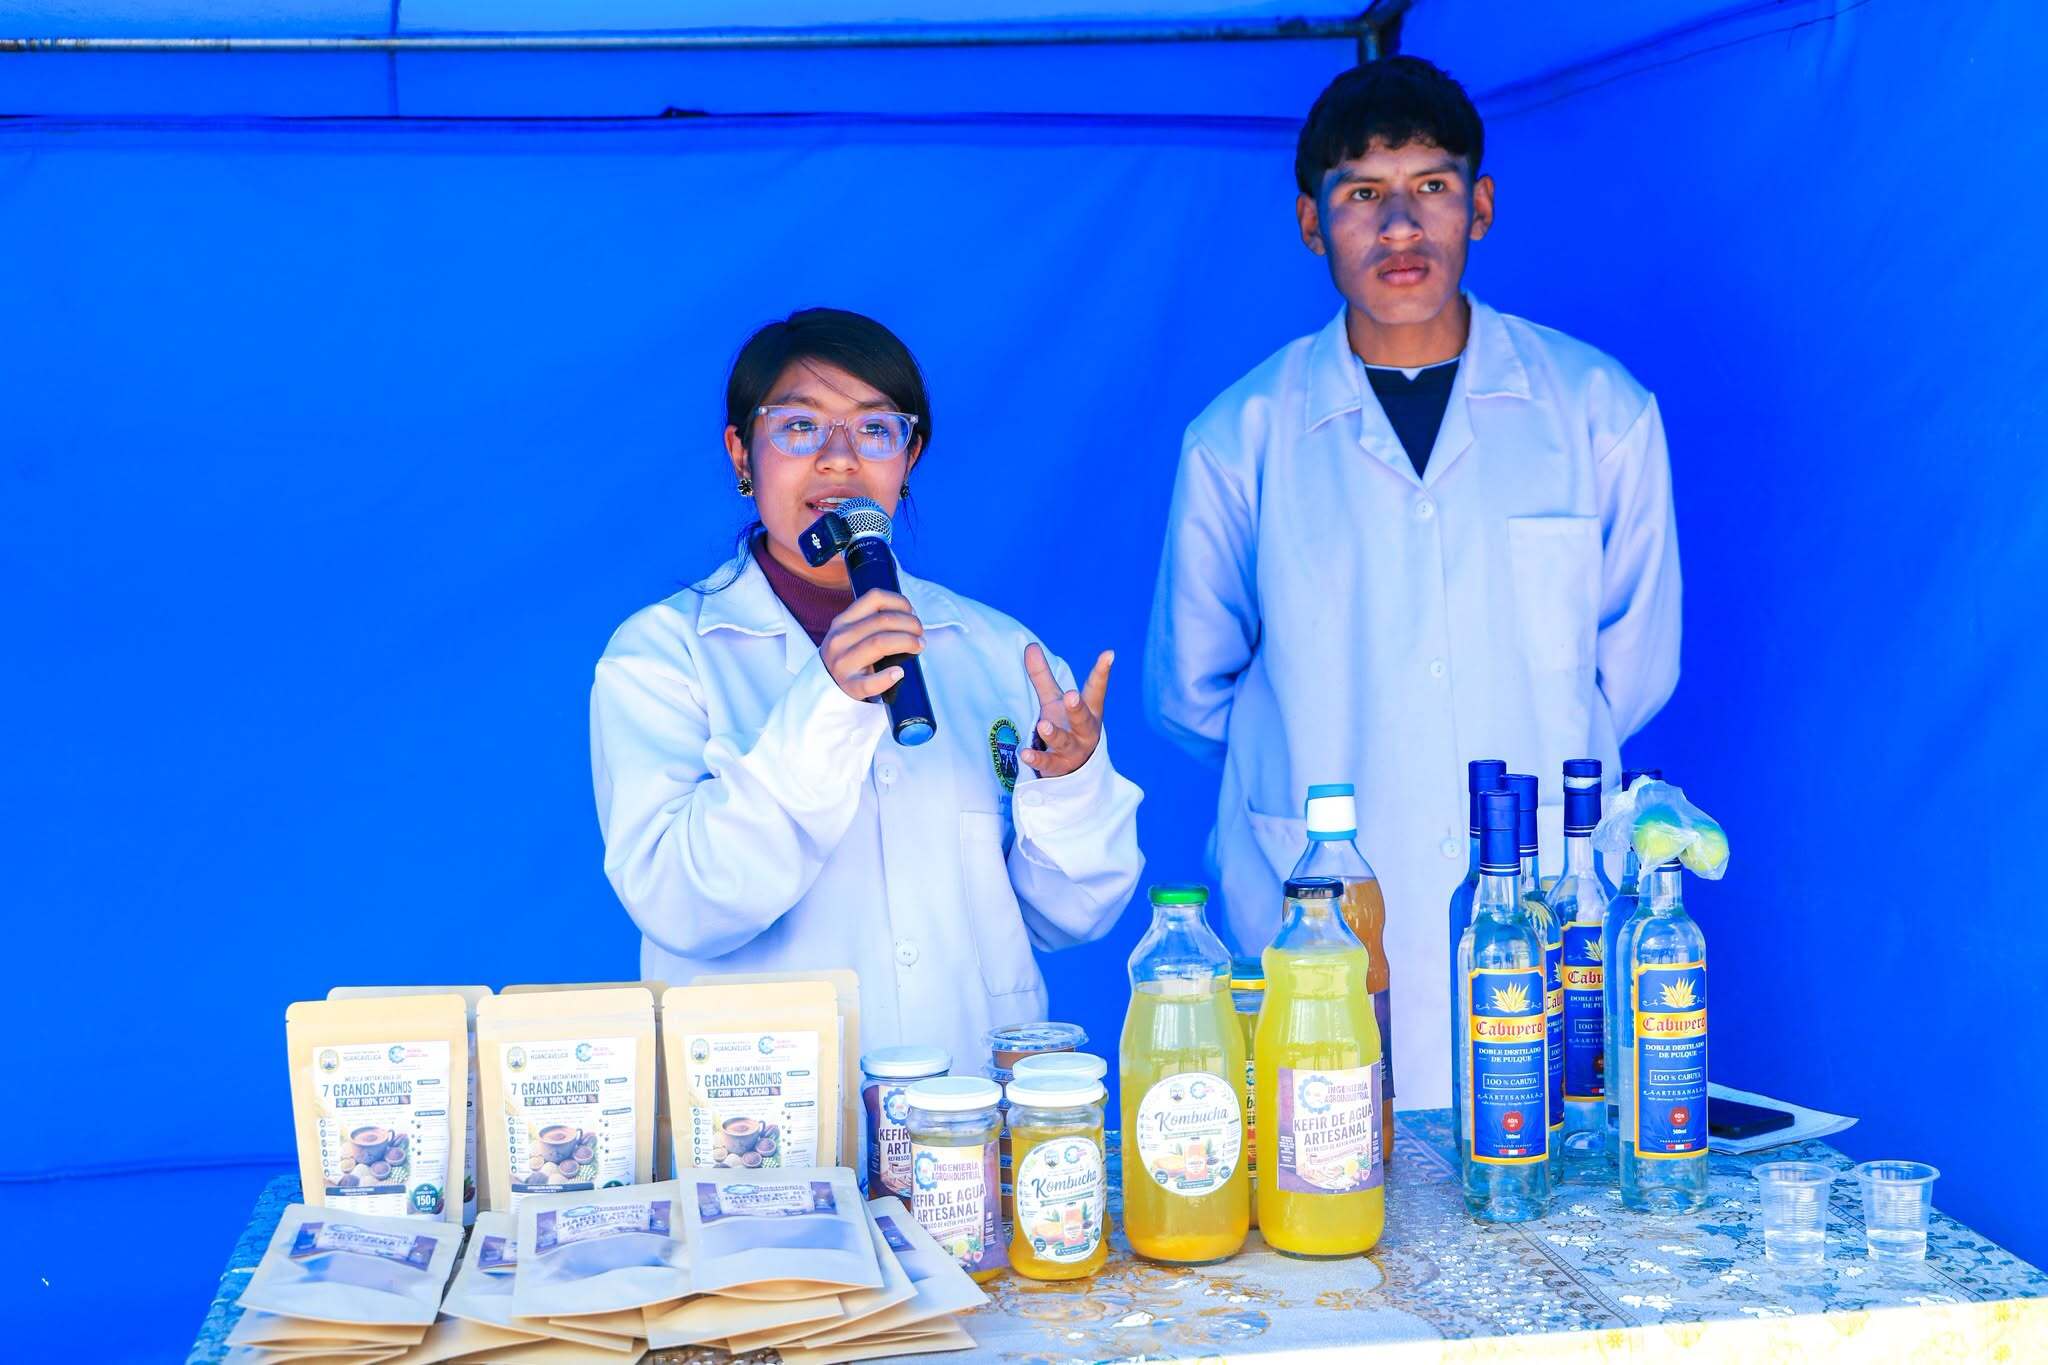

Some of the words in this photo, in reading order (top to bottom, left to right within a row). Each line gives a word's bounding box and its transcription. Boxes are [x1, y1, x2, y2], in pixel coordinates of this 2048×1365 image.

[1476, 1021, 1543, 1038] Cabuyero
[1504, 1047, 1541, 1055] DESTILADO
[511, 1083, 517, 1095] 7
[521, 1081, 563, 1096] GRANOS
[566, 1080, 600, 1093] ANDINOS
[695, 1075, 700, 1087] 7
[704, 1073, 746, 1088] GRANOS
[748, 1071, 782, 1085] ANDINOS
[322, 1085, 329, 1097] 7
[333, 1082, 376, 1097] GRANOS
[378, 1080, 412, 1094] ANDINOS
[719, 1089, 731, 1097] CON
[733, 1088, 750, 1096] 100%
[751, 1087, 769, 1095] CACAO
[346, 1098, 361, 1106] CON
[361, 1097, 378, 1105] 100%
[379, 1096, 399, 1104] CACAO
[535, 1097, 548, 1105] CON
[549, 1096, 566, 1105] 100%
[567, 1096, 587, 1104] CACAO
[1155, 1106, 1228, 1132] Kombucha
[1293, 1117, 1327, 1131] KEFIR
[1332, 1112, 1345, 1127] DE
[1349, 1103, 1373, 1124] AGUA
[880, 1128, 910, 1141] KEFIR
[1304, 1120, 1367, 1145] ARTESANAL
[1032, 1170, 1097, 1198] Kombucha
[939, 1191, 952, 1205] DE
[957, 1183, 986, 1203] AGUA
[918, 1201, 979, 1222] ARTESANAL
